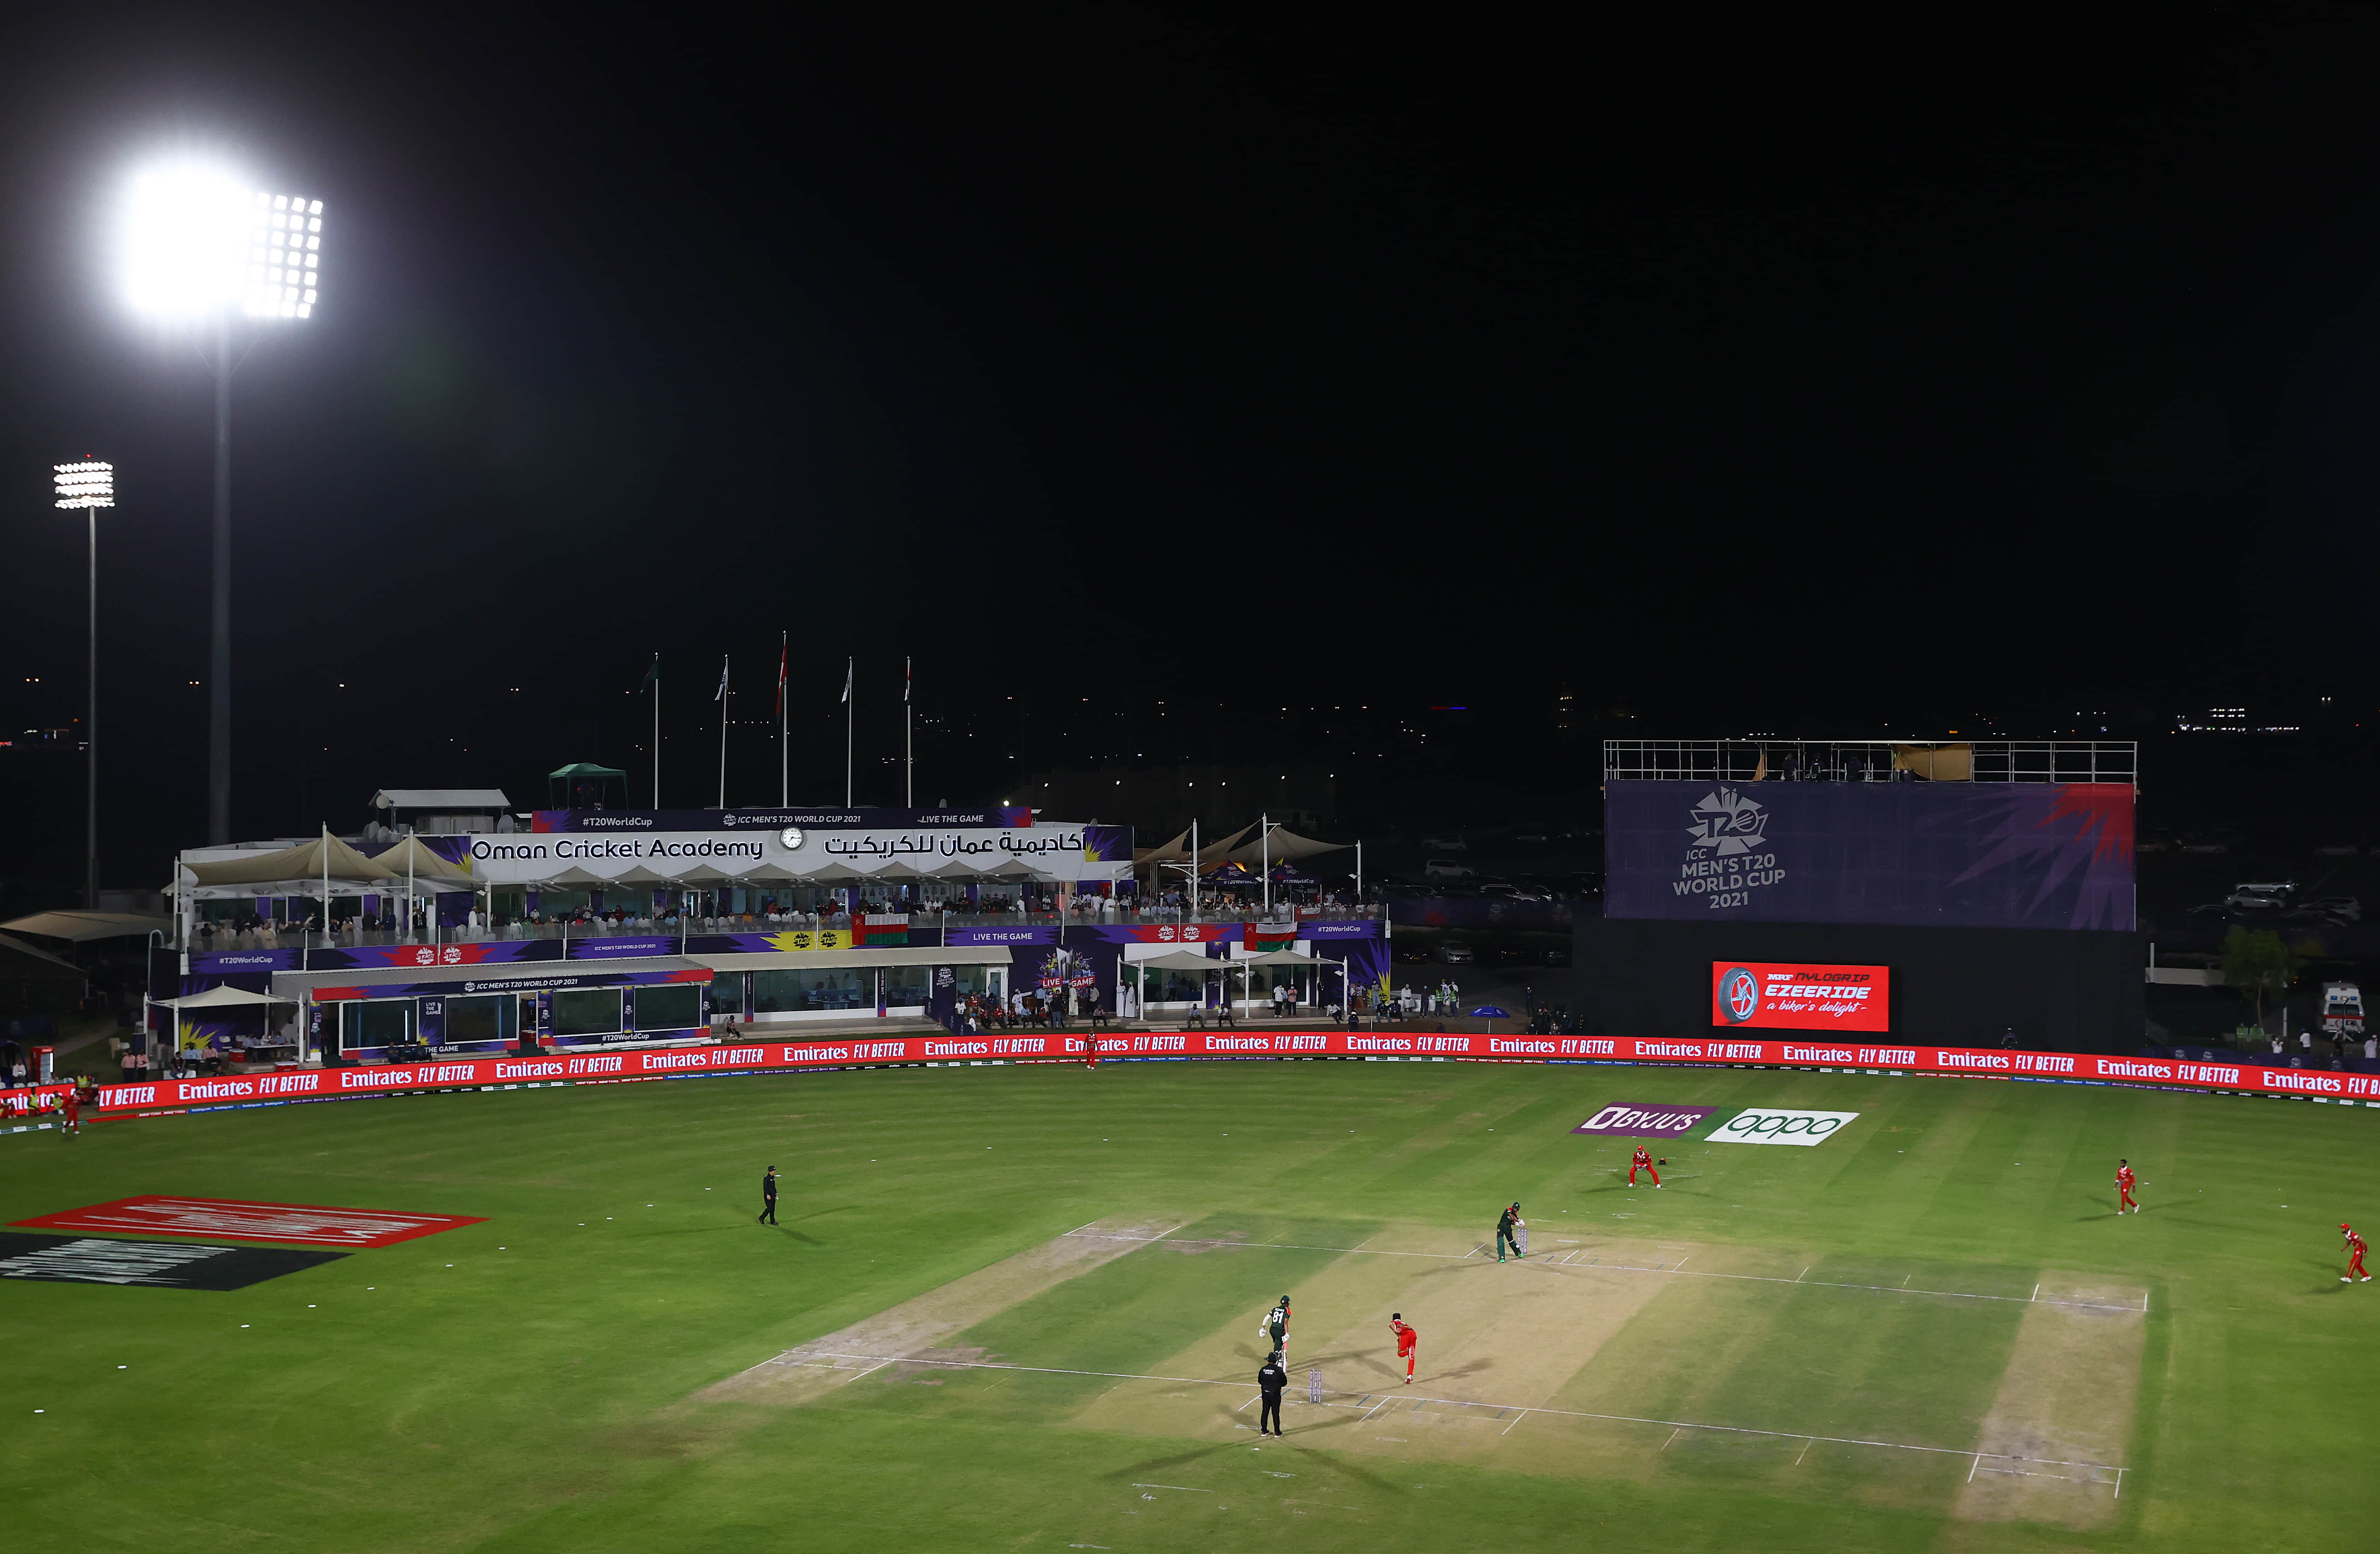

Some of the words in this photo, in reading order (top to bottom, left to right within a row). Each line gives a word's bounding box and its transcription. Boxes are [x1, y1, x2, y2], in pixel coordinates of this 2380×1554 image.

[582, 817, 652, 827] #T20WorldCup
[470, 838, 547, 860] Oman
[555, 840, 642, 858] Cricket
[648, 839, 763, 860] Academy
[825, 835, 934, 859] للكريكيت
[940, 835, 993, 857] عمان
[1686, 848, 1708, 861] ICC
[1682, 858, 1739, 878] MEN'S
[1742, 853, 1776, 870] T20
[1673, 875, 1743, 896] WORLD
[1747, 870, 1786, 887] CUP
[1710, 891, 1749, 909] 2021
[1042, 978, 1060, 987] LIVE
[1071, 977, 1093, 987] GAME
[1796, 971, 1870, 982] NYLOGRIP
[1765, 983, 1872, 999] EZEERIDE
[1778, 999, 1816, 1012] biker's
[602, 1033, 650, 1042] #T20WorldCup
[924, 1040, 988, 1055] Emirates
[993, 1039, 1010, 1053] FLY
[1011, 1038, 1045, 1053] BETTER
[1134, 1036, 1150, 1050] FLY
[1152, 1036, 1186, 1050] BETTER
[1205, 1035, 1269, 1050] Emirates
[1274, 1036, 1291, 1049] FLY
[1292, 1036, 1327, 1049] BETTER
[1346, 1036, 1411, 1050] Emirates
[1416, 1036, 1434, 1050] FLY
[1434, 1037, 1469, 1051] BETTER
[1490, 1038, 1556, 1053] Emirates
[1561, 1039, 1578, 1053] FLY
[1579, 1040, 1615, 1054] BETTER
[439, 1044, 459, 1053] GAME
[783, 1046, 848, 1061] Emirates
[853, 1044, 870, 1059] FLY
[871, 1042, 905, 1058] BETTER
[1635, 1041, 1702, 1057] Emirates
[1707, 1043, 1725, 1058] FLY
[1726, 1044, 1762, 1059] BETTER
[1783, 1046, 1853, 1062] Emirates
[1858, 1048, 1877, 1063] FLY
[1878, 1049, 1916, 1065] BETTER
[496, 1061, 563, 1078] Emirates
[569, 1058, 586, 1074] FLY
[587, 1056, 623, 1073] BETTER
[642, 1053, 706, 1069] Emirates
[711, 1050, 729, 1065] FLY
[729, 1048, 764, 1064] BETTER
[1938, 1051, 2010, 1068] Emirates
[2015, 1054, 2034, 1070] FLY
[2035, 1056, 2074, 1072] BETTER
[341, 1070, 412, 1088] Emirates
[417, 1067, 436, 1083] FLY
[437, 1065, 475, 1082] BETTER
[2097, 1059, 2171, 1078] Emirates
[2177, 1065, 2197, 1080] FLY
[2198, 1066, 2239, 1083] BETTER
[178, 1081, 253, 1100] Emirates
[259, 1076, 288, 1094] FLY
[287, 1074, 318, 1092] BETTER
[2263, 1071, 2341, 1092] Emirates
[2348, 1077, 2368, 1094] FLY
[100, 1089, 113, 1107] LY
[114, 1086, 155, 1105] BETTER
[1614, 1110, 1703, 1132] BYJU'S
[1728, 1114, 1841, 1139] oppo
[1273, 1311, 1284, 1324] 81
